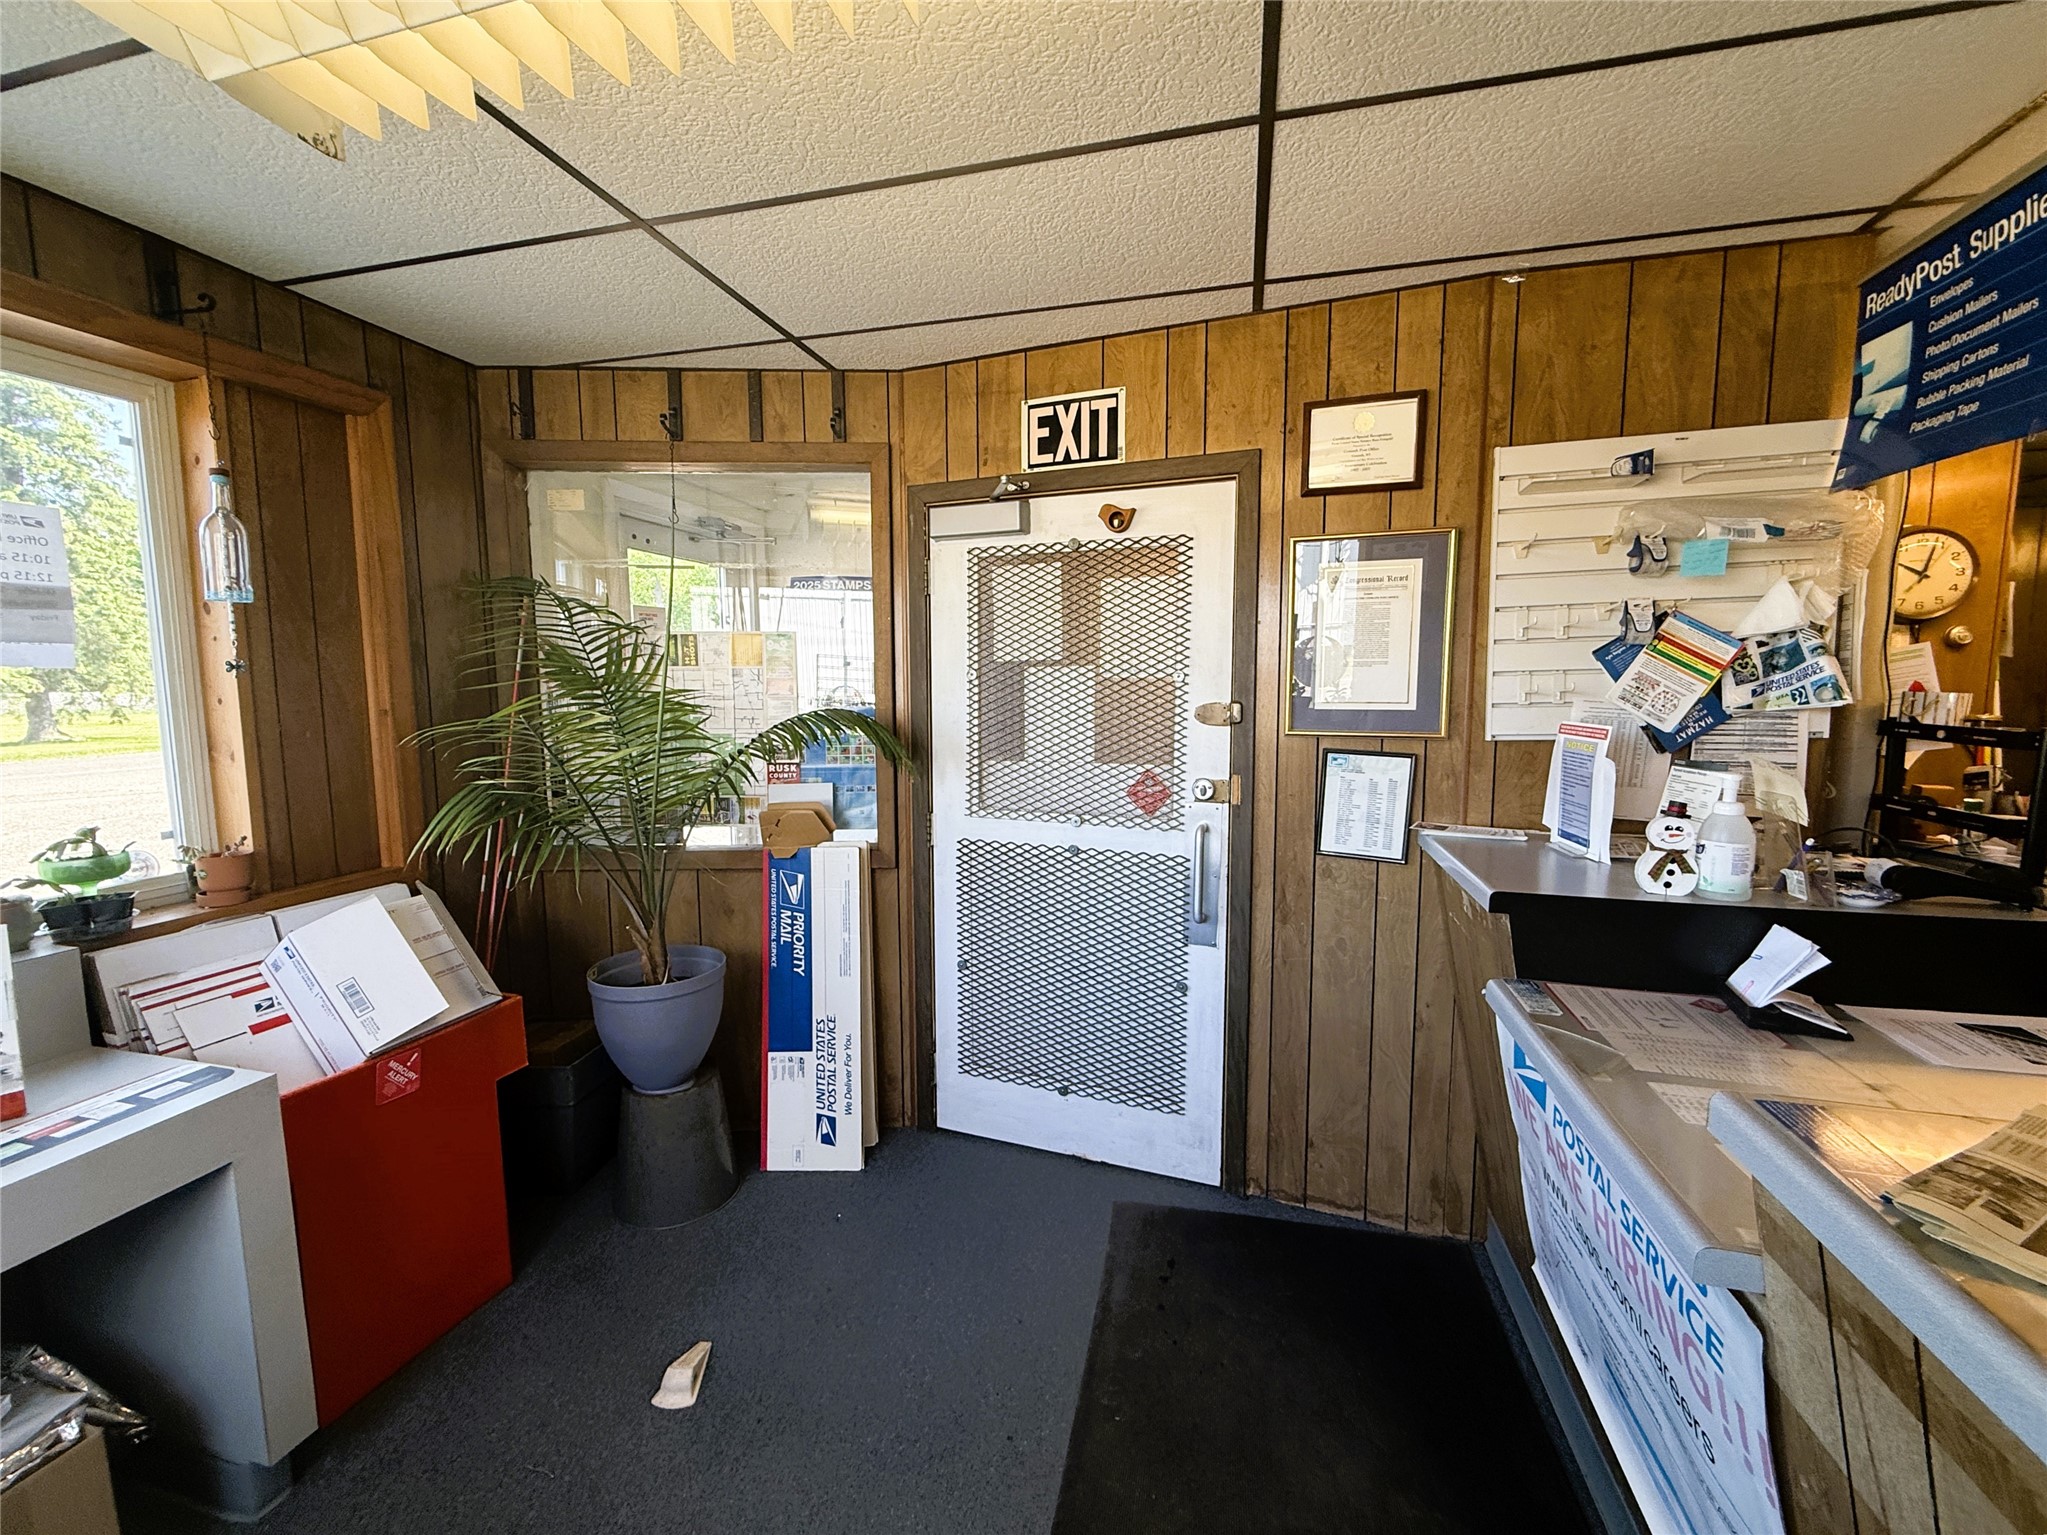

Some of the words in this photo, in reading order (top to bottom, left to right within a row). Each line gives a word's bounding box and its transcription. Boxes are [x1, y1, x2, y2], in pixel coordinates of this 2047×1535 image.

[1865, 244, 1964, 319] ReadyPost
[1930, 277, 1974, 308] Envelopes
[1928, 308, 1964, 334] Cushion
[1965, 291, 1999, 315] Mailers
[1925, 315, 2001, 359] Photo/Document
[2002, 298, 2039, 324] Mailers
[1922, 360, 1960, 384] Shipping
[1961, 343, 1999, 367] Cartons
[1916, 389, 1947, 409] Bubble
[1948, 374, 1986, 396] Packing
[1987, 354, 2030, 381] Material
[1029, 397, 1117, 465] EXIT
[1909, 410, 1956, 434] Packaging
[1957, 401, 1980, 417] Tape
[1951, 551, 1961, 561] 2
[793, 580, 822, 590] 2025
[822, 580, 872, 590] STAMPS
[1387, 574, 1409, 583] Record
[1955, 567, 1966, 577] 3
[1934, 595, 1944, 605] 5
[1948, 583, 1959, 592] 4
[1897, 598, 1906, 607] 7
[1914, 601, 1924, 610] 6
[1766, 673, 1796, 687] UNITED
[1795, 661, 1820, 677] STATES
[1766, 681, 1794, 693] POSTAL
[1795, 665, 1825, 683] SERVICE
[1791, 688, 1808, 703] 32
[1675, 715, 1714, 743] HAZMAT
[1566, 740, 1595, 752] NOTICE
[768, 764, 797, 772] RUSK
[780, 909, 792, 945] MAIL
[793, 911, 805, 977] PRIORITY
[816, 1018, 826, 1062] STATES
[827, 1014, 837, 1065] SERVICE
[844, 1033, 852, 1052] You.
[387, 1060, 419, 1081] MERCURY
[844, 1053, 852, 1068] For
[387, 1070, 409, 1085] ALERT
[816, 1062, 826, 1110] UNITED
[827, 1066, 837, 1113] POSTAL
[844, 1068, 852, 1101] Deliver
[844, 1102, 852, 1116] We
[1552, 1104, 1616, 1214] POSTAL
[1620, 1198, 1725, 1375] SERVICE
[1507, 1067, 1540, 1142] WE
[1543, 1121, 1588, 1216] ARE
[1592, 1188, 1778, 1511] HIRING!!!
